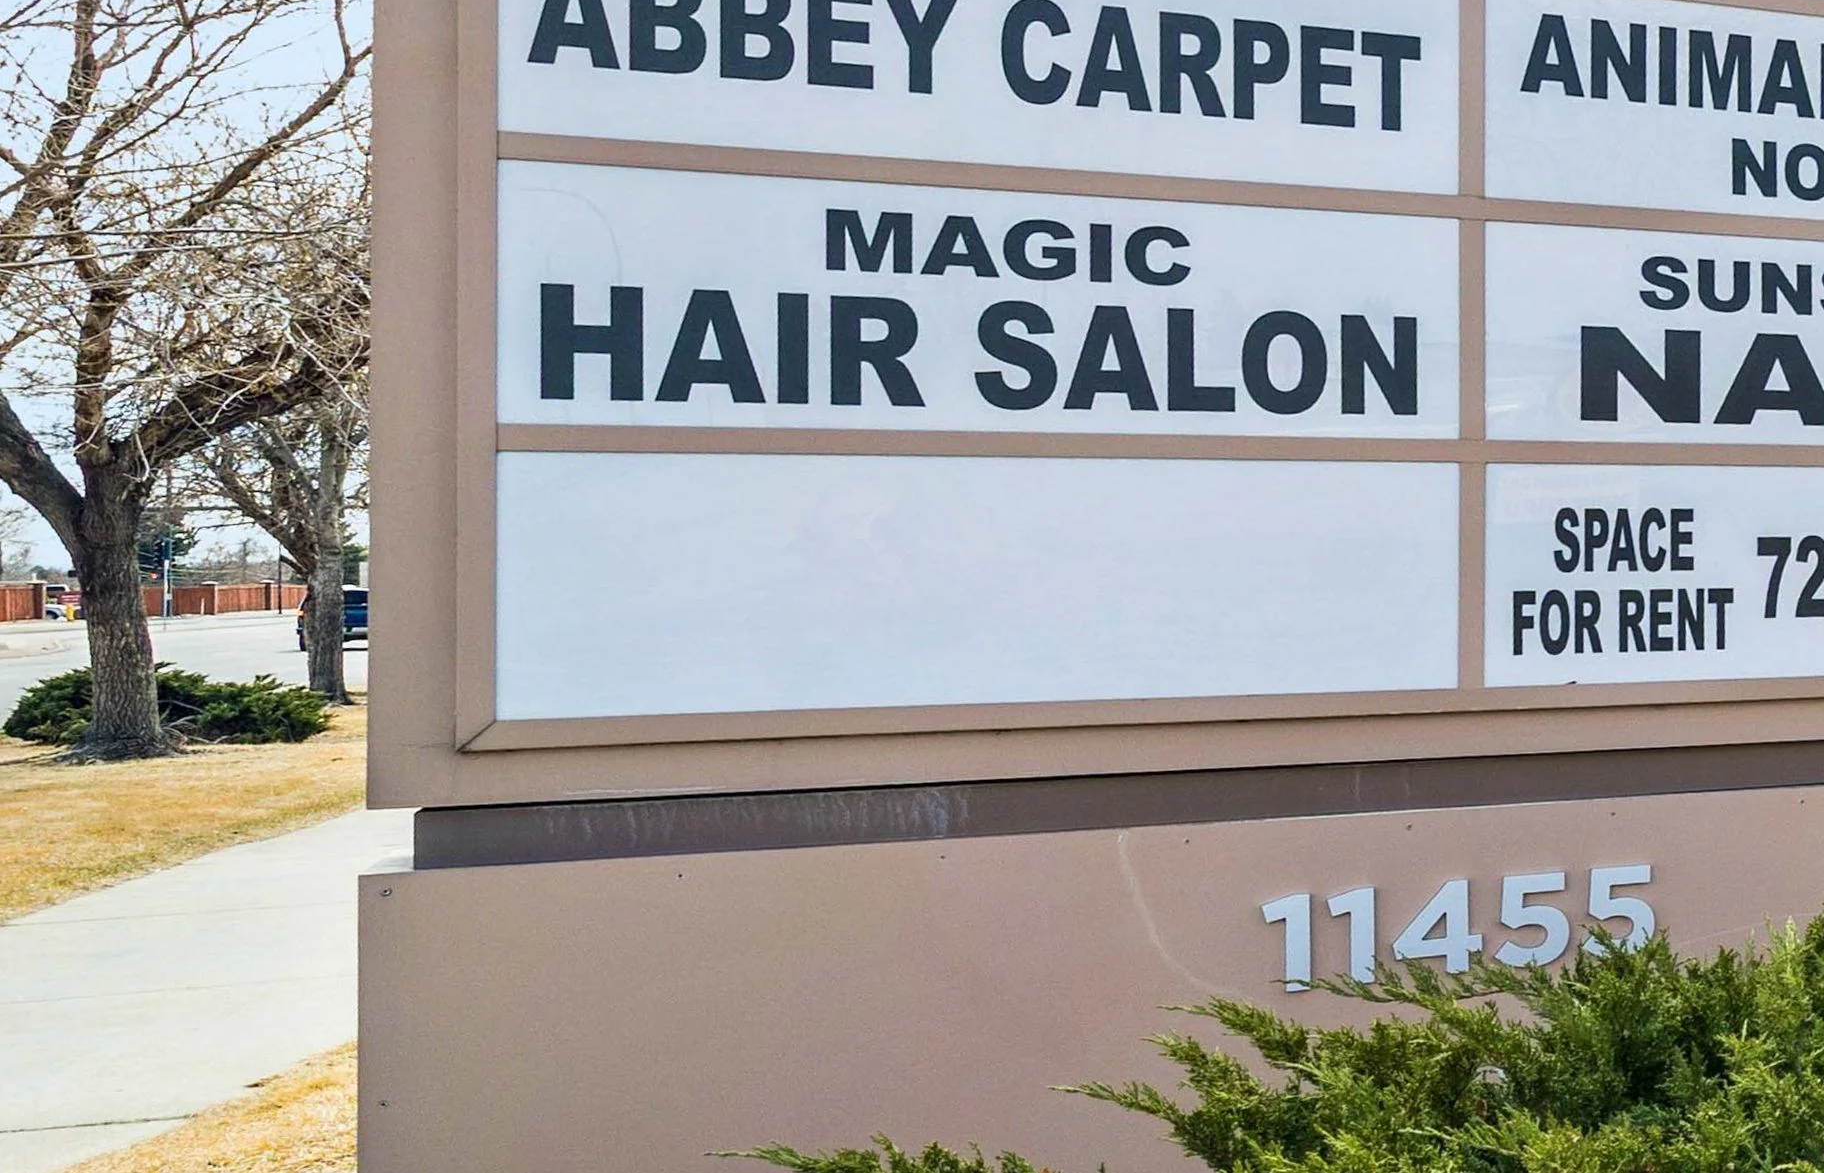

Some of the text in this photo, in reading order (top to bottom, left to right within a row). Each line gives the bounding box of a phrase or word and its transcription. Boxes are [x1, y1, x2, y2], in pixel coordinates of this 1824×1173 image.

[825, 208, 1192, 286] MAGIC
[540, 282, 1418, 416] HAIR SALON
[1553, 507, 1695, 573] SPACE
[1512, 587, 1734, 656] FOR RENT
[1261, 864, 1656, 993] 11455
